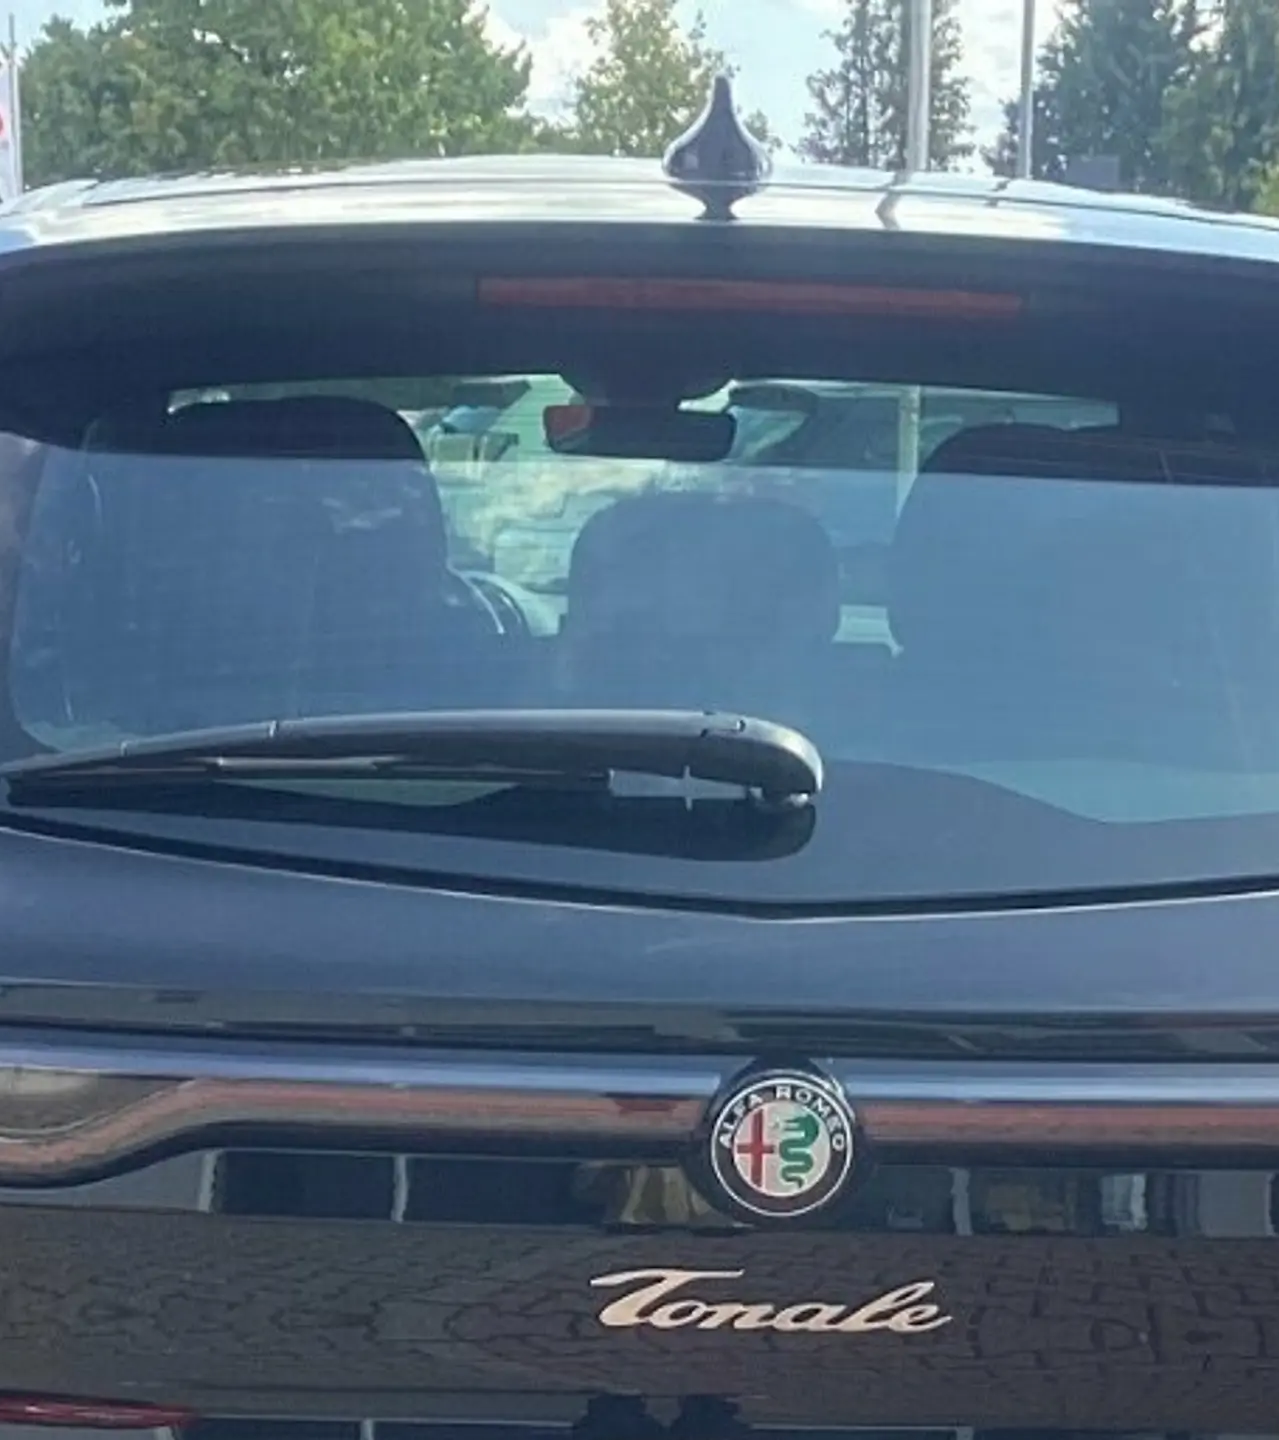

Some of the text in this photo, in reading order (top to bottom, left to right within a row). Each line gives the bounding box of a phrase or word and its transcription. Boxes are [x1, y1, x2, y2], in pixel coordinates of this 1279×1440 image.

[719, 1085, 845, 1151] ALFA ROMEO
[590, 1268, 953, 1333] Tonale
